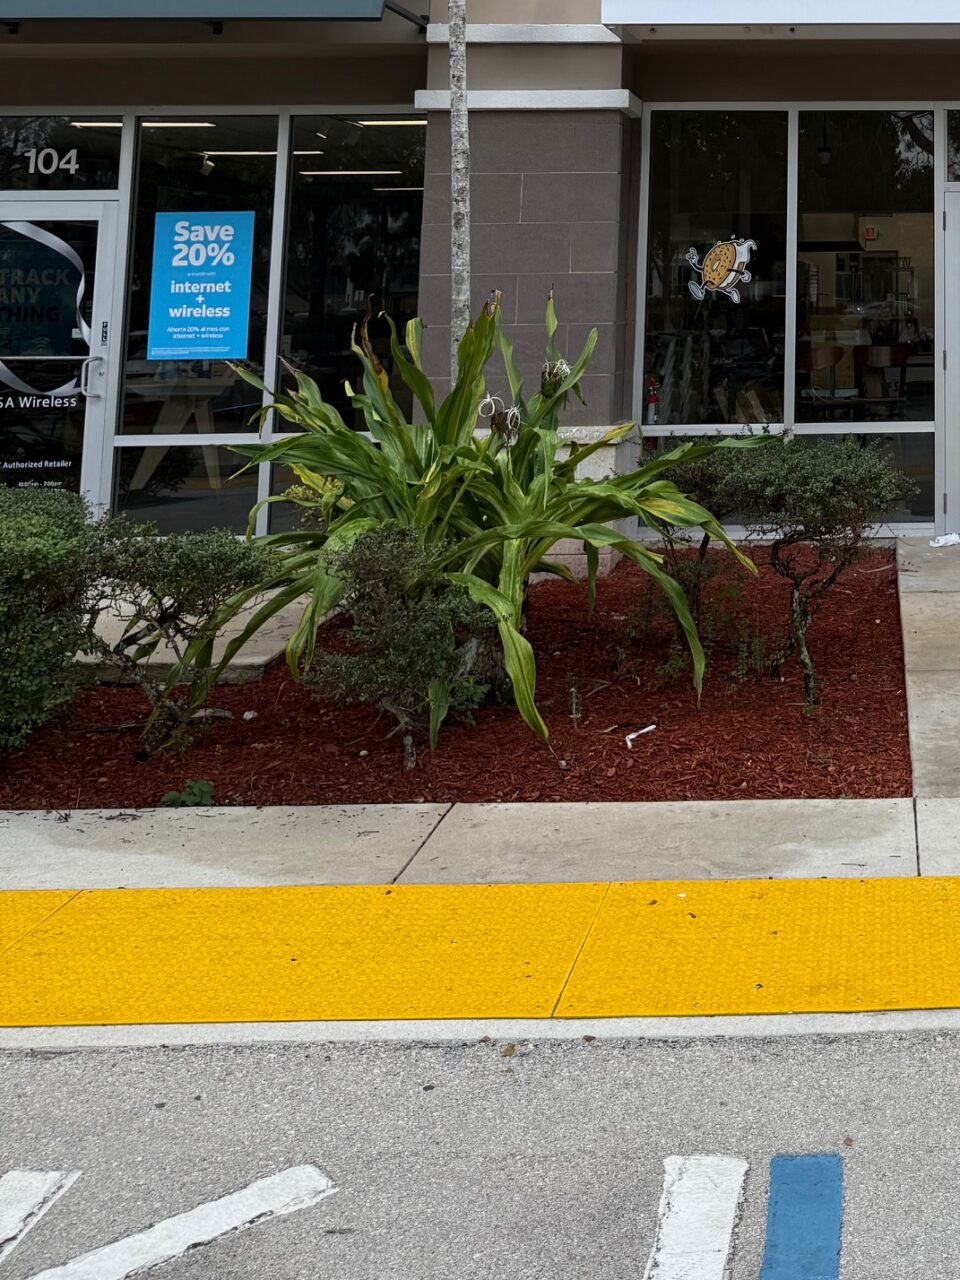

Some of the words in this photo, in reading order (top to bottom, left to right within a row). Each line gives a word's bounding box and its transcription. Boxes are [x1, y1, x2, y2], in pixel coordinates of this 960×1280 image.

[24, 147, 80, 175] 104
[173, 220, 235, 242] Save
[171, 243, 235, 267] 20%
[170, 280, 232, 294] internet
[169, 304, 231, 318] wireless
[19, 395, 77, 409] Wireless
[2, 460, 43, 469] Authorized
[44, 459, 72, 468] Retailer
